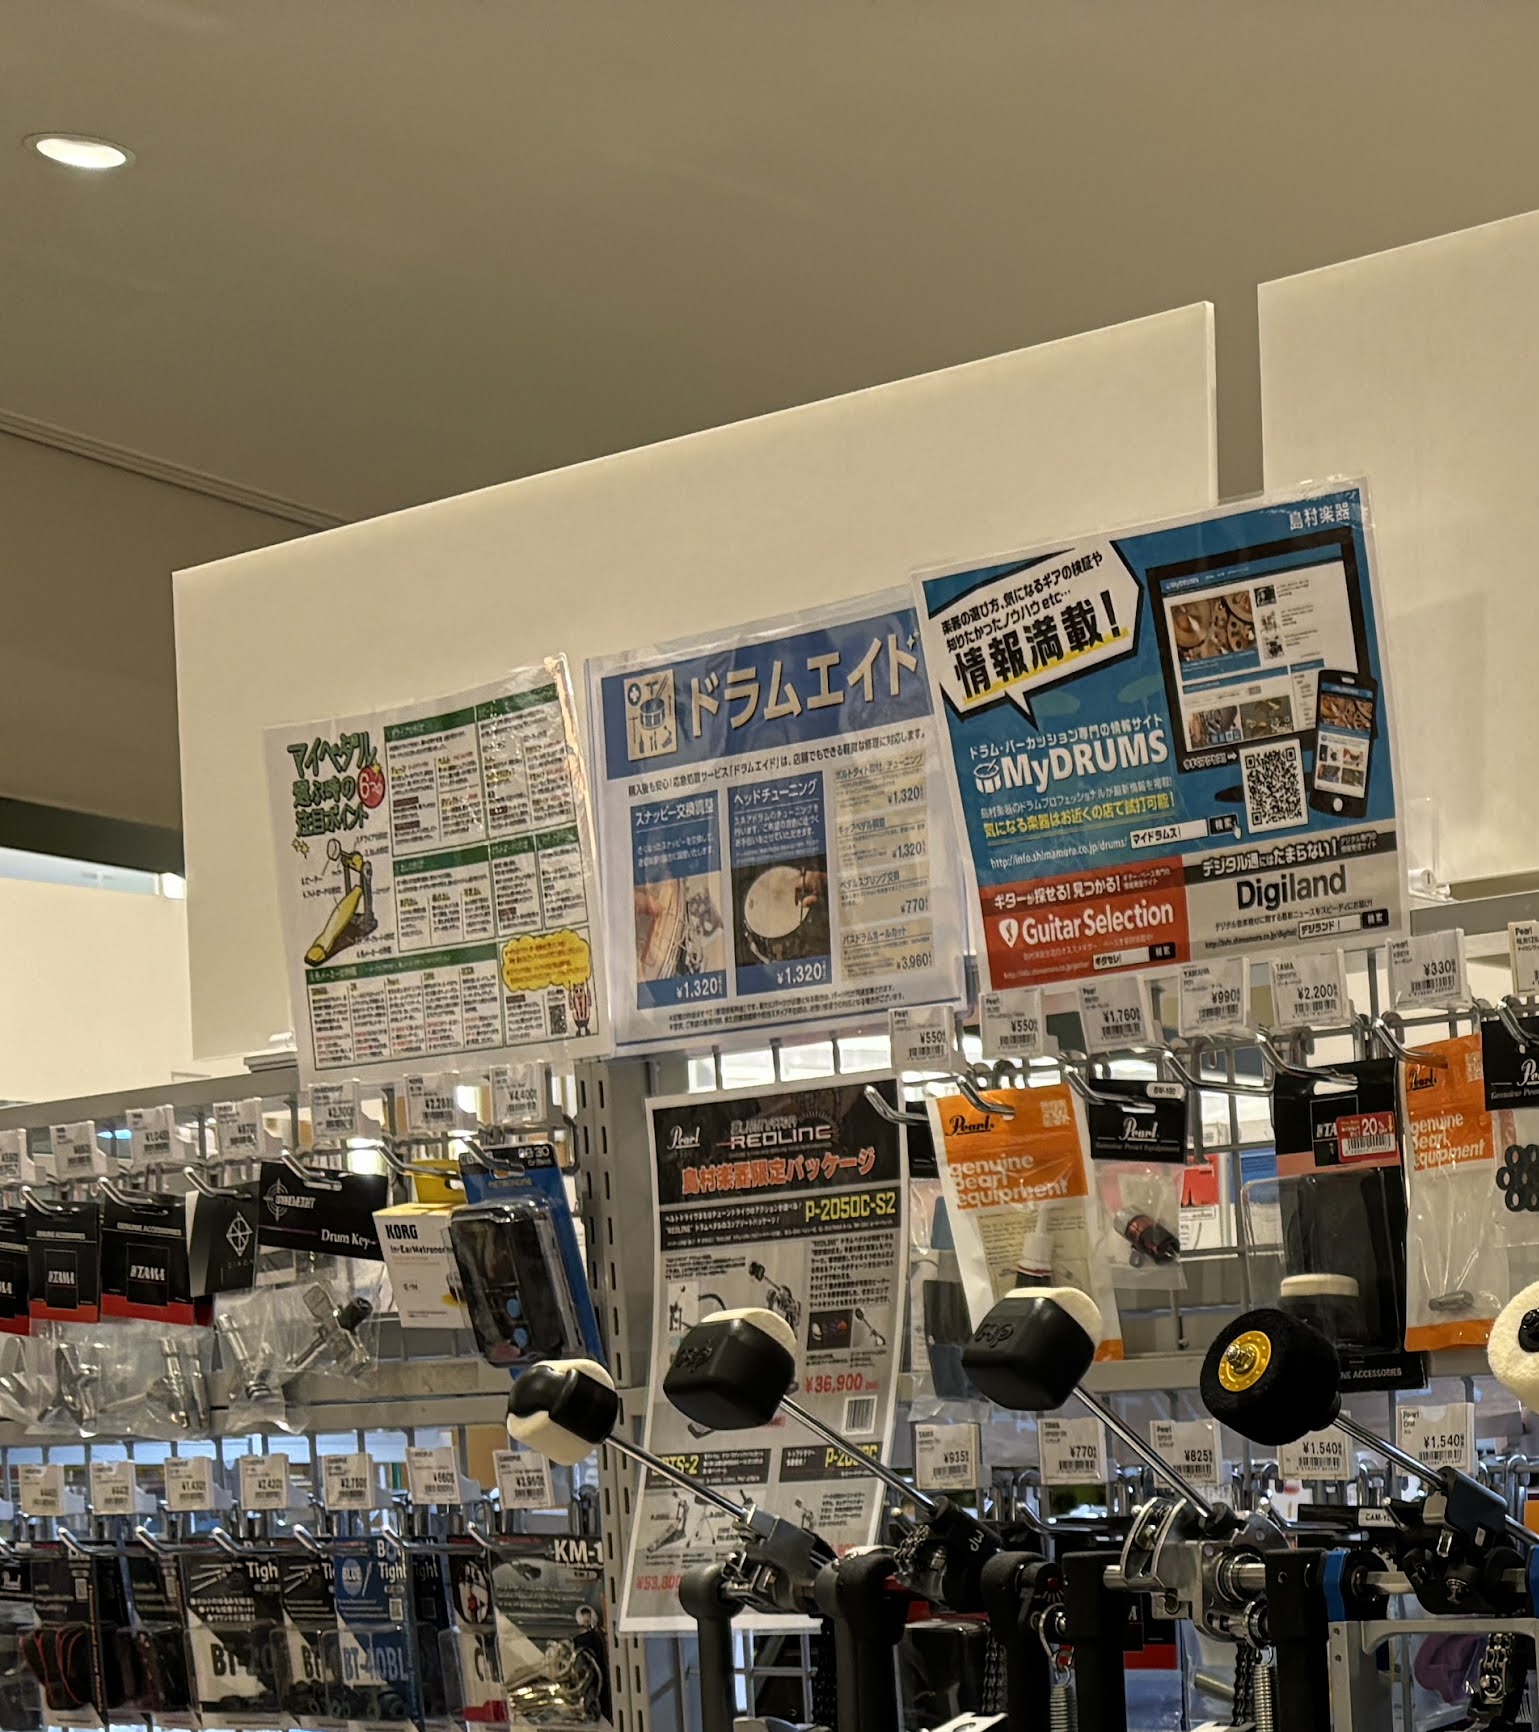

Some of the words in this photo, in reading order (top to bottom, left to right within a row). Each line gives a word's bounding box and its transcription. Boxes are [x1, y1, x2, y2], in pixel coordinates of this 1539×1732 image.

[1288, 502, 1351, 531] 島村楽器
[954, 590, 1121, 698] 情報満載!
[689, 631, 920, 738] ドラムエイド
[1002, 730, 1169, 793] MyDRUMS
[734, 779, 817, 806] ヘッドチューニング
[1237, 865, 1347, 911] Digiland
[1022, 915, 1082, 944] Guitar
[1084, 899, 1174, 937] Selection
[676, 979, 718, 999] ¥1,320
[946, 1114, 995, 1136] Pearl
[805, 1192, 896, 1222] P-2050C-S2
[385, 1222, 418, 1240] KORG
